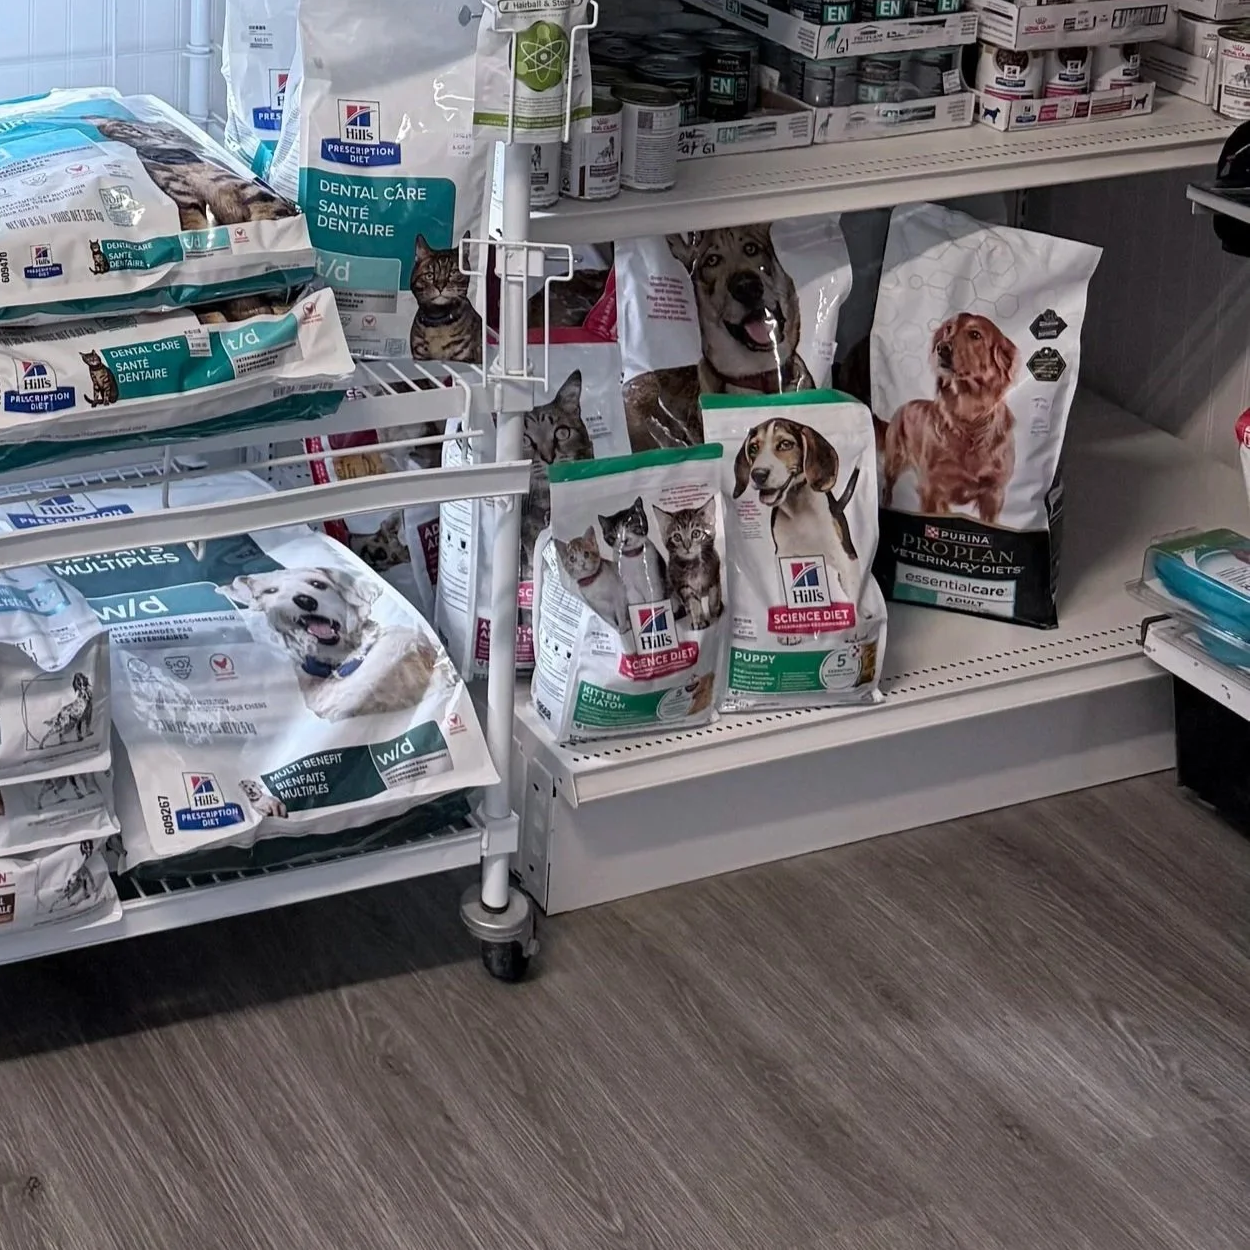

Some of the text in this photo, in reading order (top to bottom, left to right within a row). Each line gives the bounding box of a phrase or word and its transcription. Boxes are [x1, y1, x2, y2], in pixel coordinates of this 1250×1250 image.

[513, 0, 541, 10] Hairball
[880, 1, 900, 17] EN
[827, 6, 848, 21] EN
[836, 38, 849, 54] GI
[711, 77, 732, 94] EN
[346, 127, 374, 141] Hill's
[717, 128, 736, 142] EN
[327, 144, 395, 156] PRESCRIPTION
[350, 155, 370, 165] DIET
[319, 179, 427, 201] DENTAL CARE
[318, 199, 369, 221] SANTÉ
[317, 216, 395, 238] DENTAIRE
[108, 251, 133, 260] SANTÉ
[1, 252, 10, 283] 609470
[109, 259, 145, 268] DENTAIRE
[110, 345, 152, 359] DENTAL
[153, 340, 180, 352] CARE
[115, 357, 150, 372] SANTÉ
[24, 377, 52, 390] Hill's
[118, 368, 168, 384] DENTAIRE
[940, 530, 990, 545] PURINA
[902, 532, 1015, 564] PRO PLAN
[890, 545, 1020, 575] VETERINARY DIETS
[905, 572, 1004, 597] essentialcare
[792, 588, 825, 605] Hill's
[946, 596, 985, 608] ADULT
[773, 609, 849, 623] SCIENCE DIET
[640, 633, 673, 650] Hill's
[734, 652, 776, 665] PUPPY
[837, 653, 847, 667] 5
[581, 693, 626, 710] CHATON
[582, 685, 621, 703] KITTEN
[194, 793, 219, 806] Hill's
[158, 795, 175, 835] 609267
[202, 818, 220, 827] DIET
